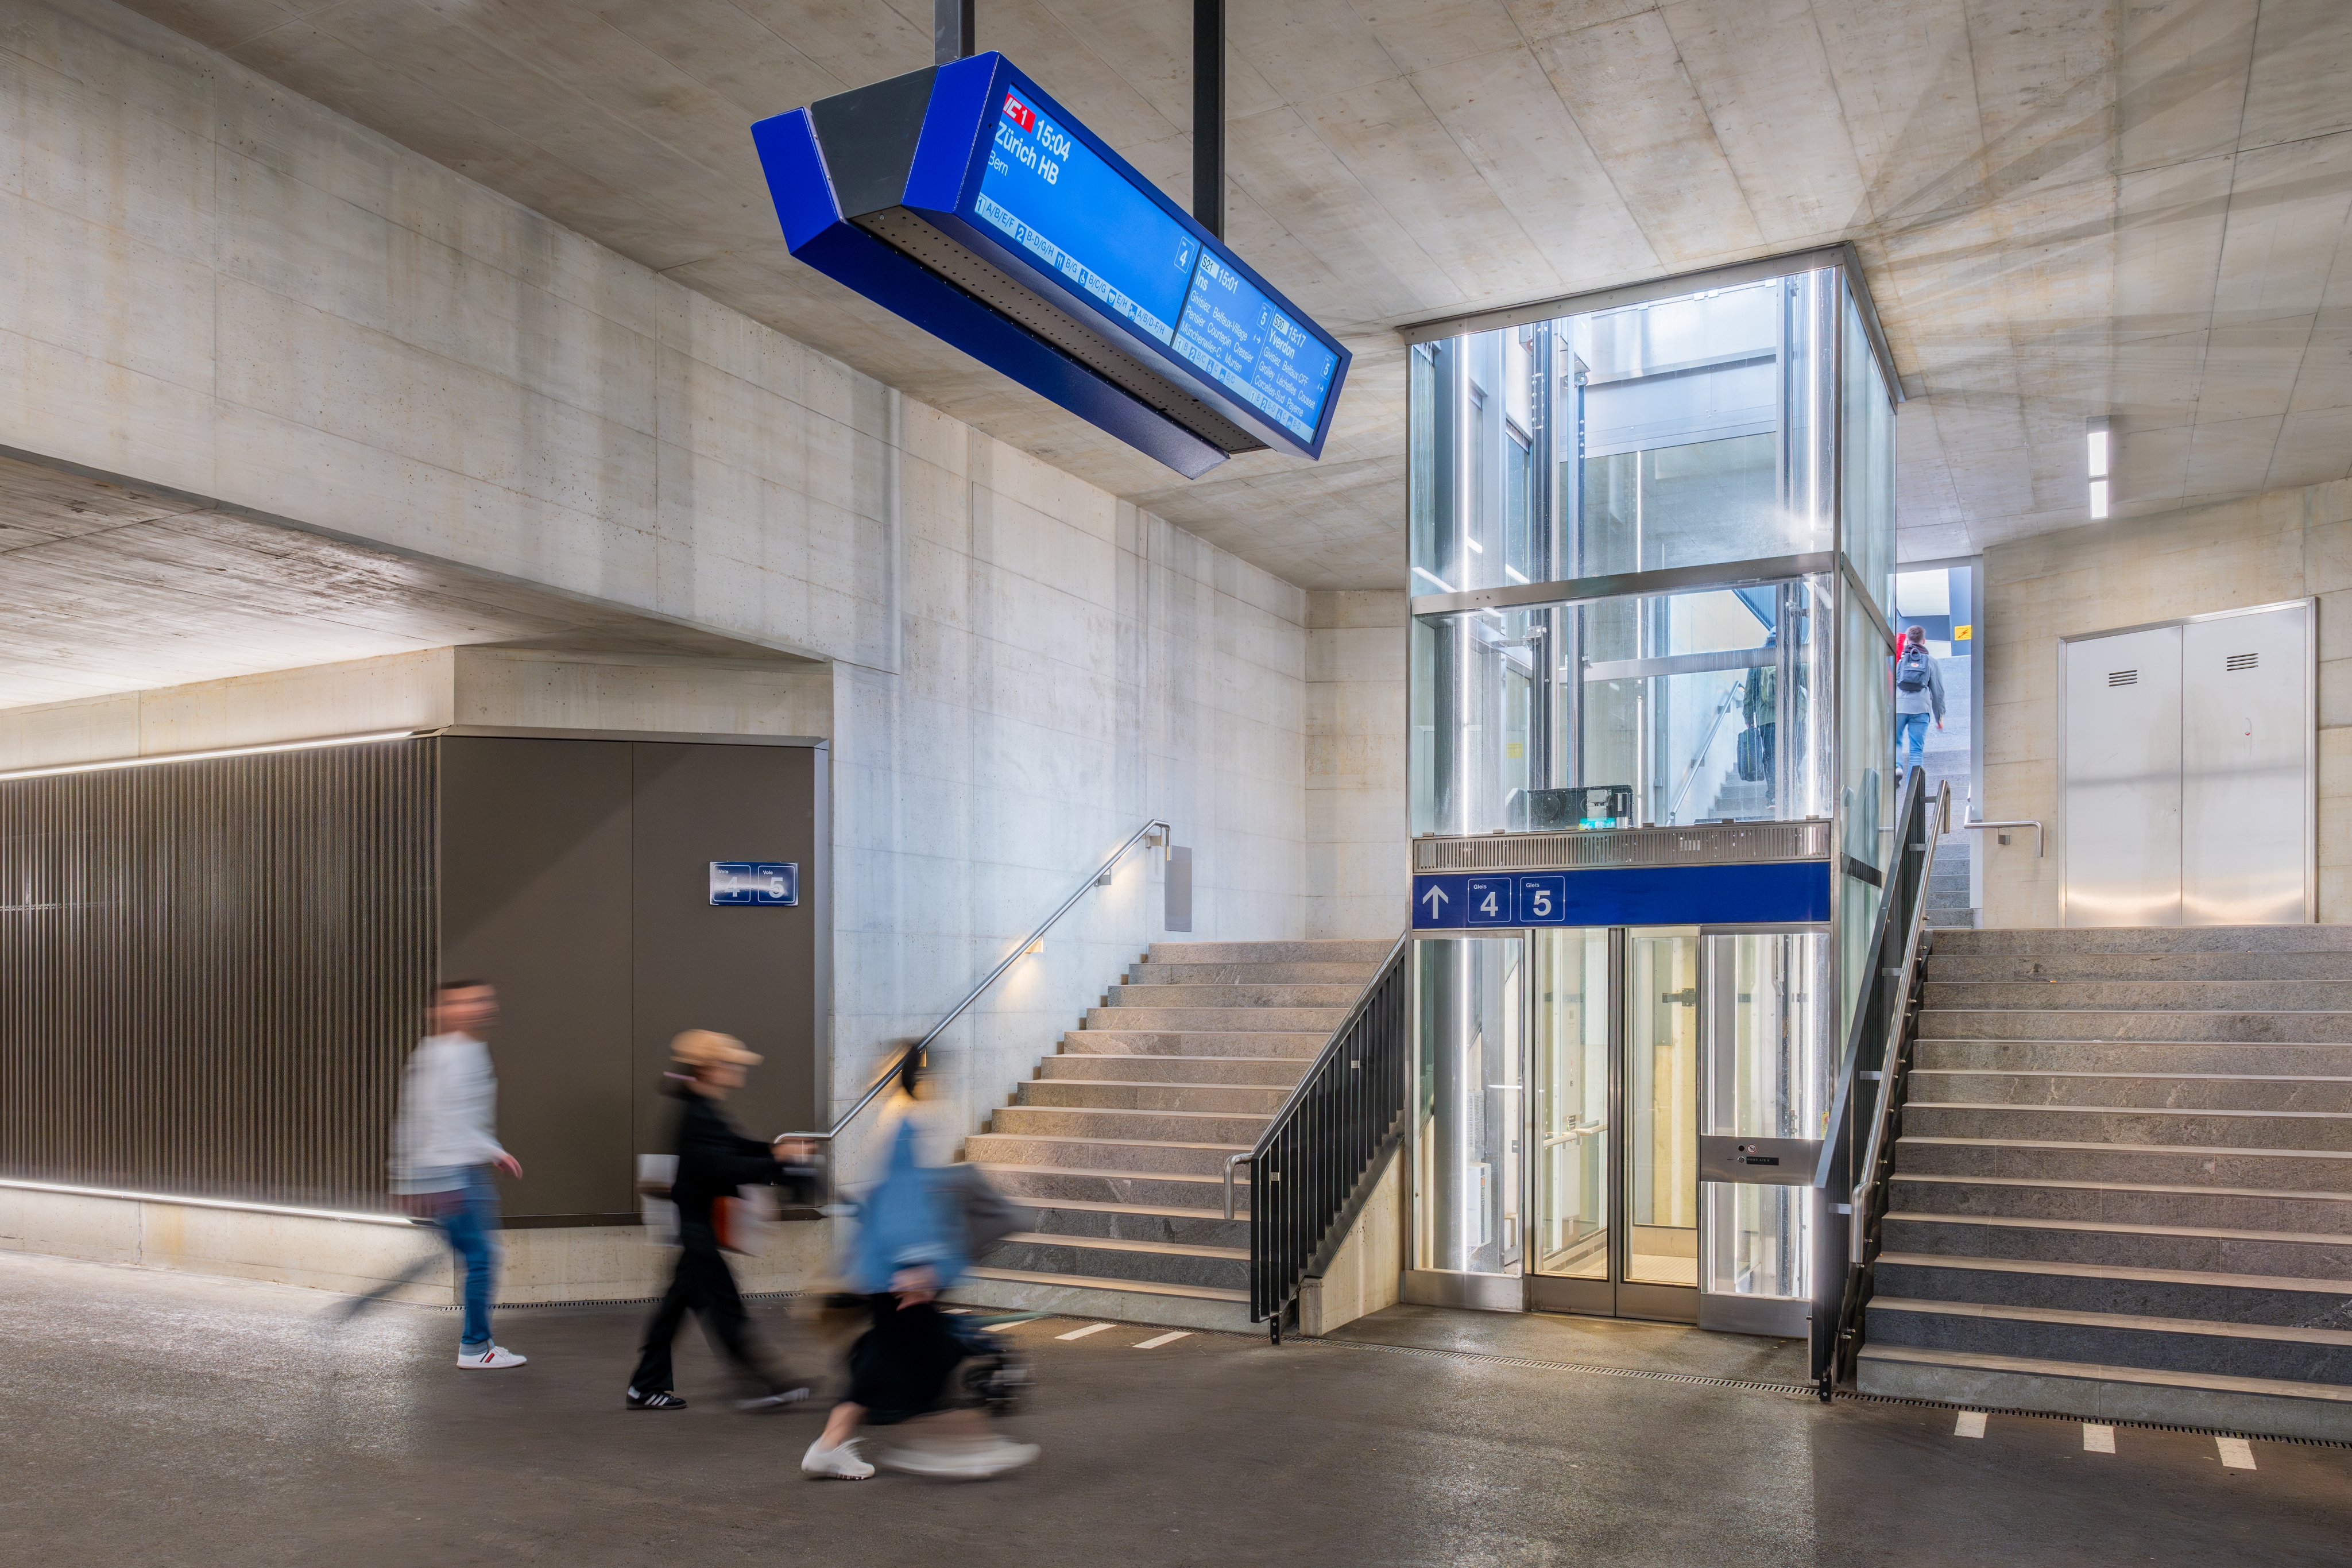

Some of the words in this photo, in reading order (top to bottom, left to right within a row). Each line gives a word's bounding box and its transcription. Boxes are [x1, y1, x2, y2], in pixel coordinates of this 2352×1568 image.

[1003, 96, 1022, 118] IC
[1021, 109, 1027, 125] 1
[1036, 119, 1071, 162] 15:04
[988, 150, 1008, 176] Bern
[995, 121, 1036, 169] Zürich
[1038, 154, 1059, 185] HB
[978, 198, 982, 211] 1
[987, 203, 1015, 227] A/B/E/F
[1016, 227, 1023, 242] 2
[1027, 231, 1054, 257] B-D/G/H
[1066, 258, 1077, 273] B/G
[1089, 275, 1106, 293] B/C/G
[1117, 295, 1128, 308] E/H
[1137, 310, 1165, 335] A/B/D-F/H
[1179, 250, 1187, 266] 4
[1195, 270, 1208, 291] Ins
[1202, 257, 1213, 272] S21
[1218, 269, 1239, 294] 15:01
[1190, 290, 1211, 313] Givisiez
[1213, 307, 1248, 341] Belfaux-Village
[1260, 312, 1267, 326] 5
[1181, 320, 1221, 359] Münchenwiler-C.
[1224, 353, 1242, 373] Murten
[1185, 305, 1206, 327] Pensier
[1208, 322, 1232, 348] Courtepin
[1233, 342, 1254, 363] Cressier
[1269, 328, 1295, 359] Yverdon
[1274, 316, 1285, 330] S30
[1289, 326, 1306, 348] 15:17
[1178, 339, 1182, 352] 1
[1189, 349, 1195, 361] 2
[1197, 353, 1206, 363] B/C
[1264, 346, 1281, 366] Givisiez
[1282, 361, 1299, 381] Belfaux
[1298, 373, 1309, 386] CFF
[1324, 363, 1330, 375] 5
[1251, 391, 1255, 402] 1
[1261, 401, 1267, 411] 2
[1254, 375, 1285, 404] Corcelles-Sud
[1286, 398, 1303, 417] Payerne
[1259, 361, 1275, 381] Grolley
[1276, 374, 1297, 396] Léchelles
[1298, 390, 1316, 410] Cousset
[726, 876, 740, 897] 4
[769, 877, 784, 899] 5
[1480, 892, 1498, 917] 4
[1533, 890, 1551, 916] 5
